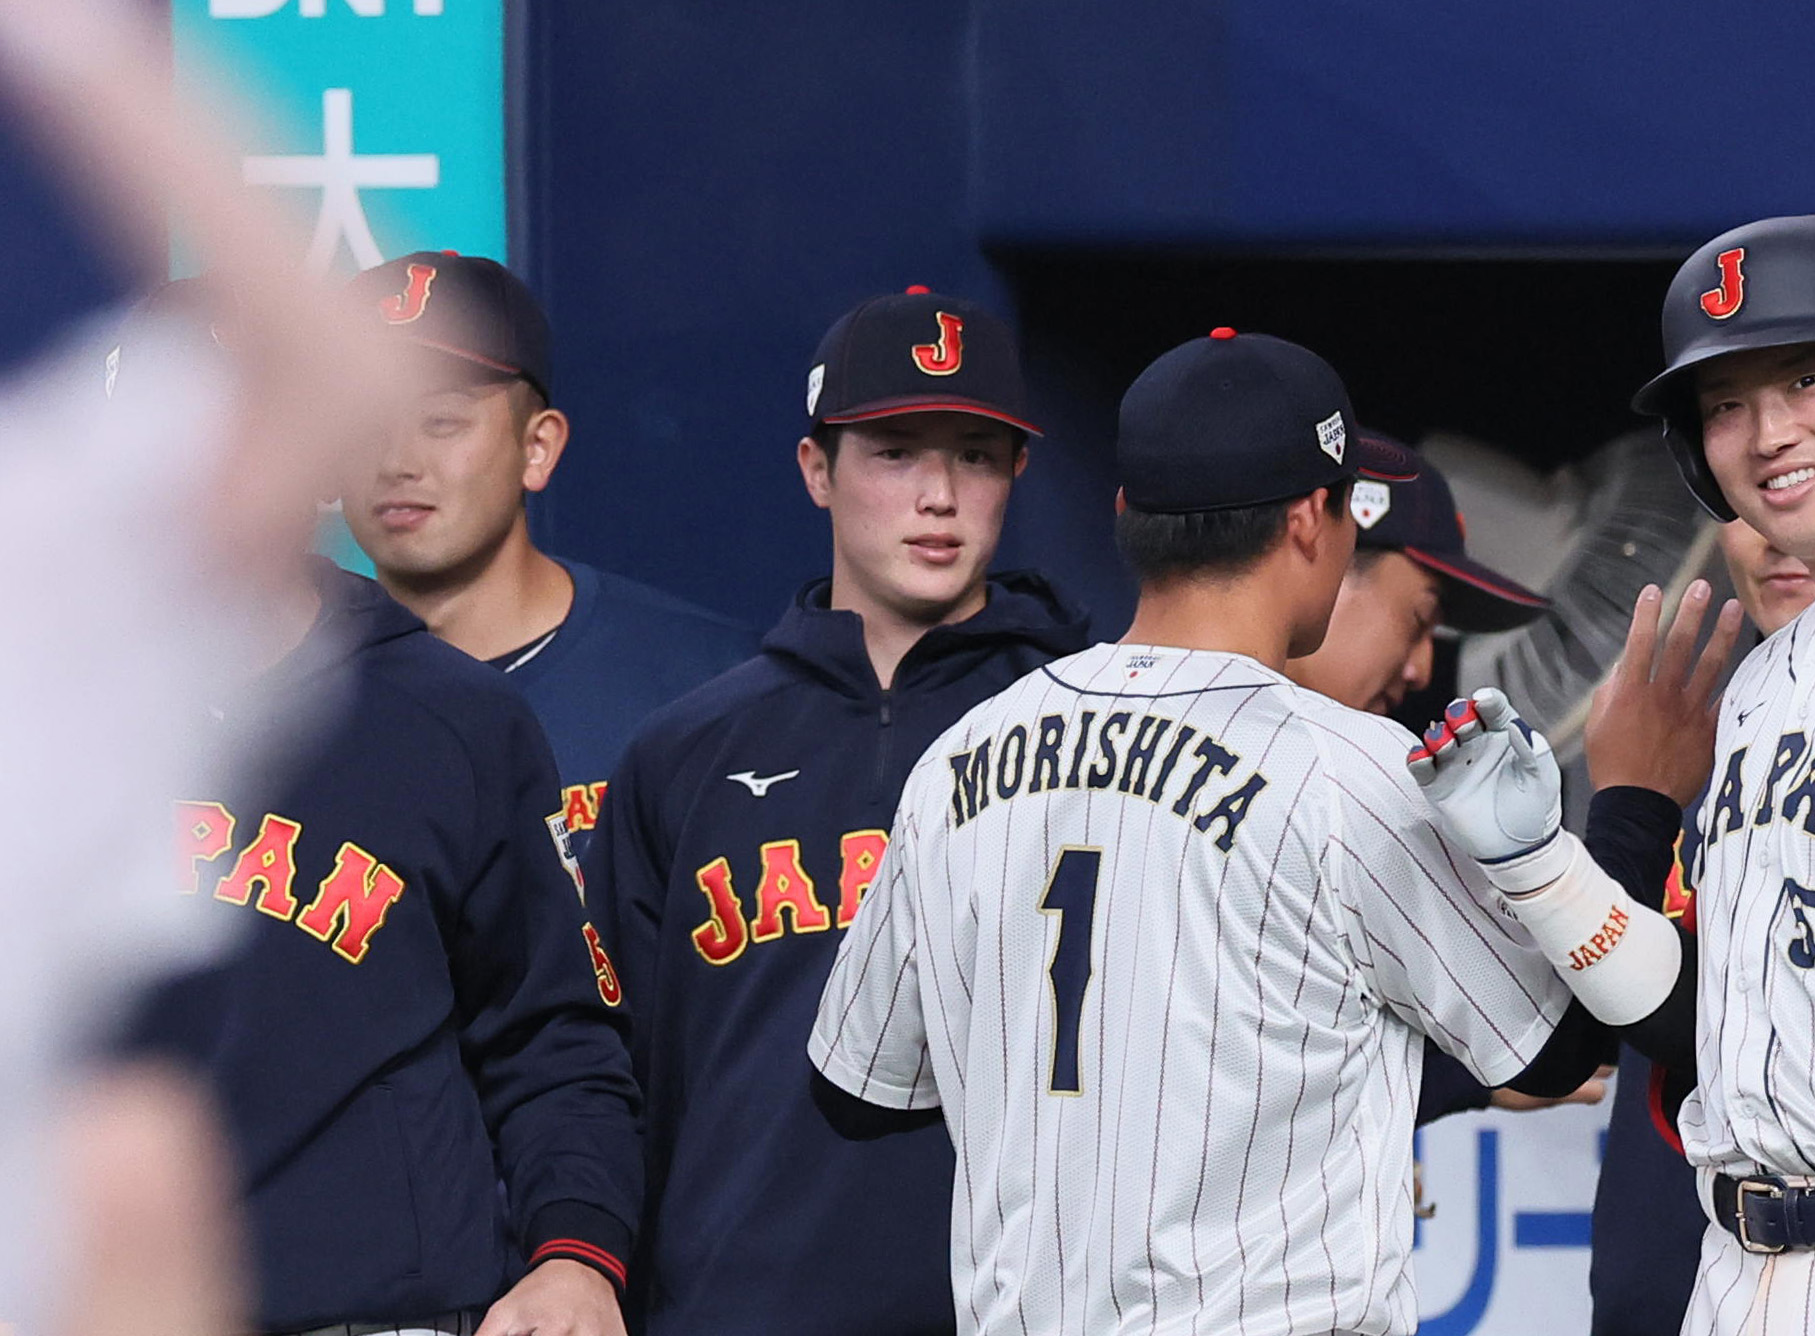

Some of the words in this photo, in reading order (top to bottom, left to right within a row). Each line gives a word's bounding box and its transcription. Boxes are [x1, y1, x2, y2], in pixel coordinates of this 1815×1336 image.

[380, 264, 436, 324] J
[1700, 247, 1745, 320] J
[911, 310, 965, 376] J
[948, 710, 1269, 856] MORISHITA
[173, 800, 405, 965] PAN
[1036, 844, 1104, 1097] 1
[1568, 903, 1630, 972] JAPAN
